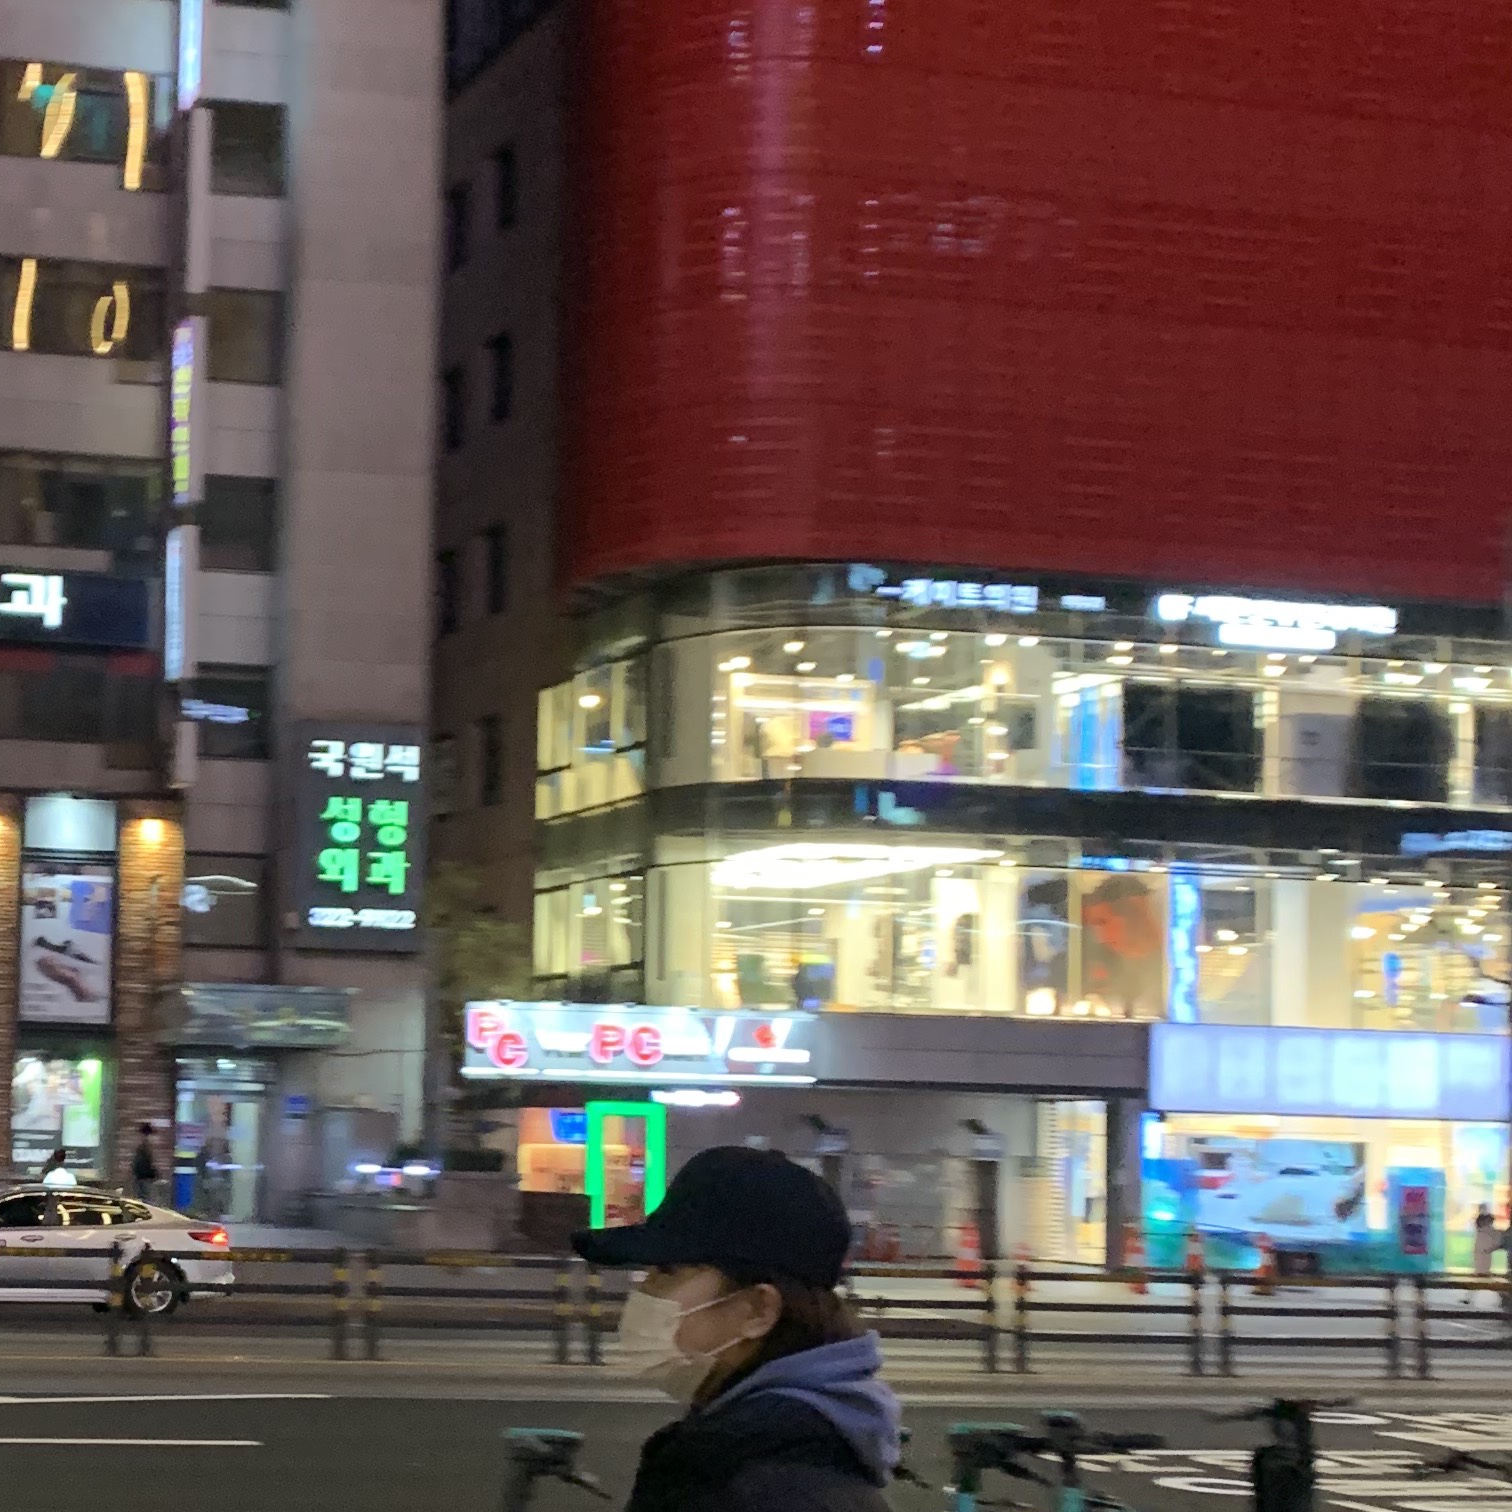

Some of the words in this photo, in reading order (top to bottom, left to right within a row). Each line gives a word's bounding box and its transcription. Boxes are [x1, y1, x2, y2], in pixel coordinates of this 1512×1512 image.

[307, 739, 421, 782] 국원석
[319, 796, 409, 846] 성형
[316, 847, 411, 895] 외과
[589, 1024, 665, 1066] PC
